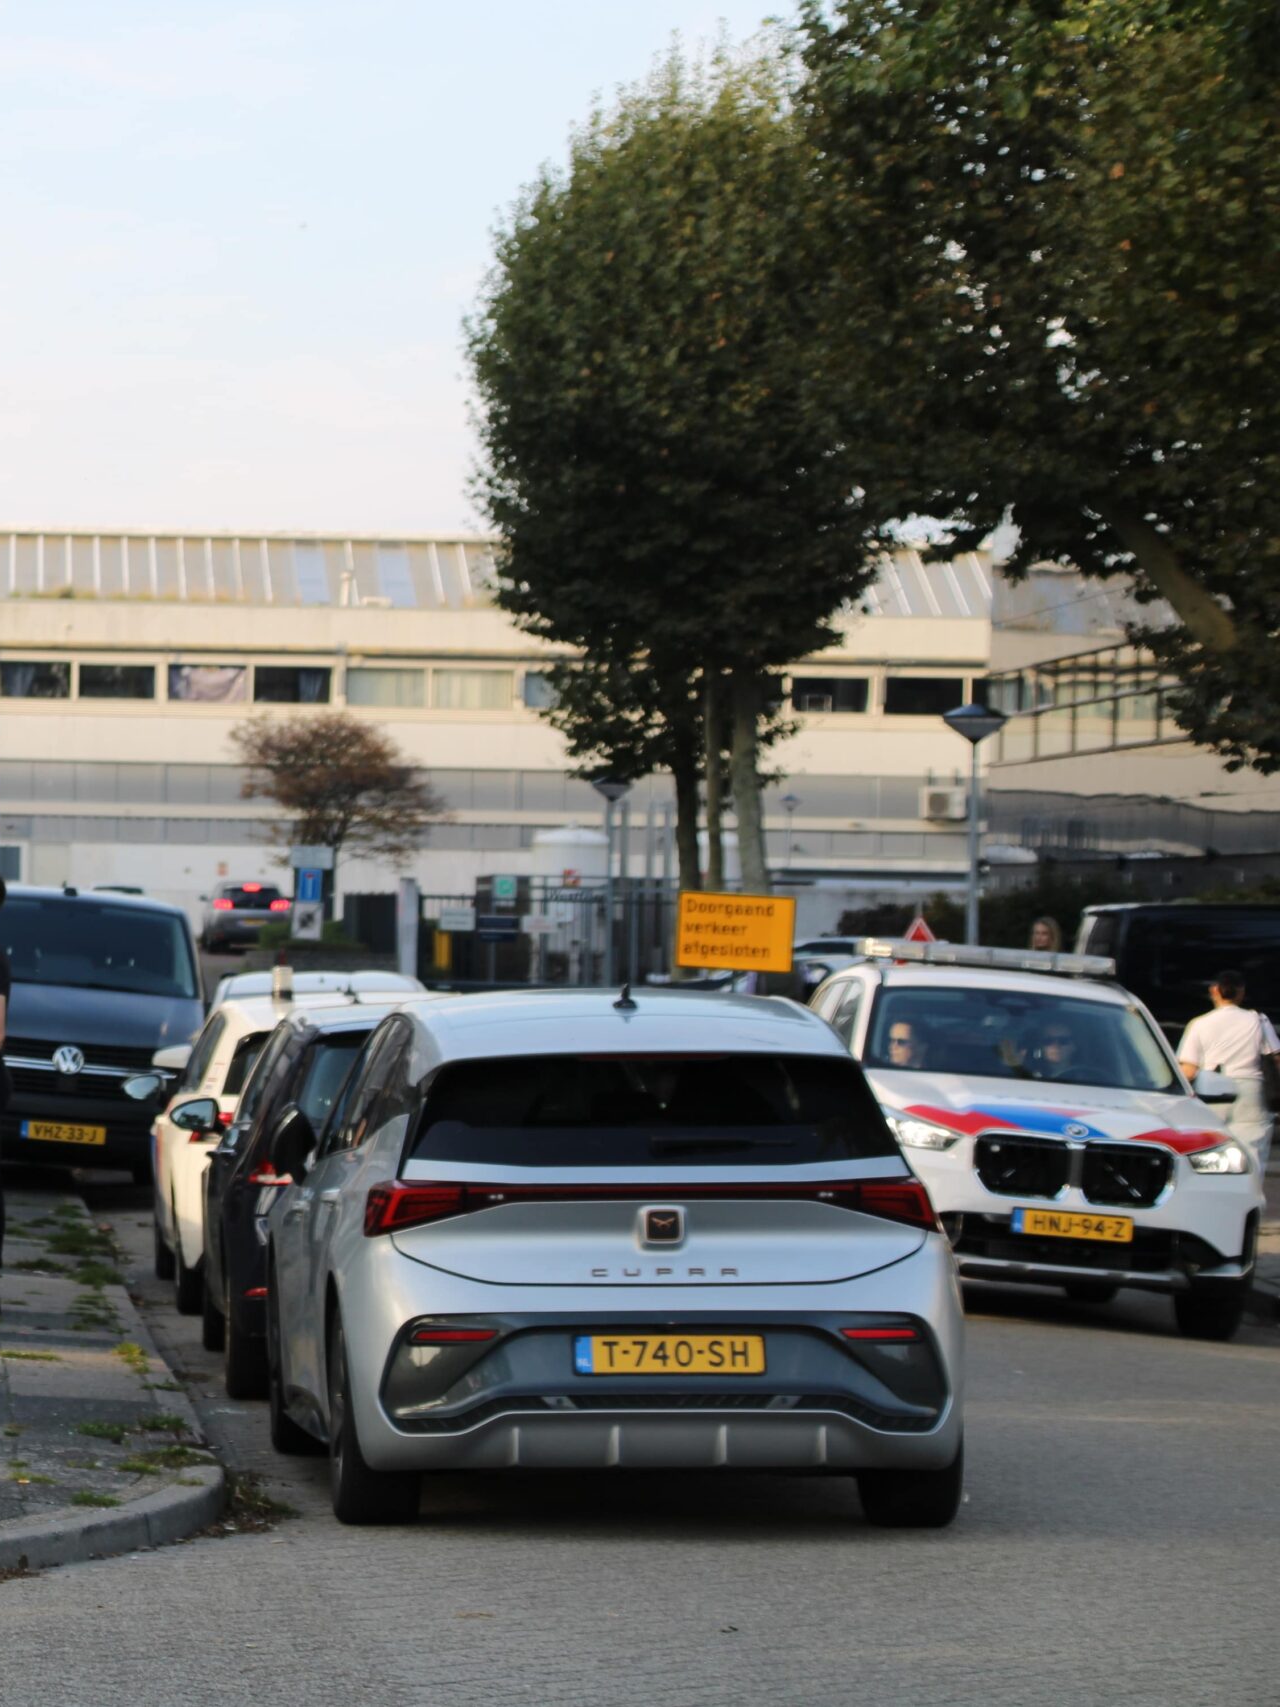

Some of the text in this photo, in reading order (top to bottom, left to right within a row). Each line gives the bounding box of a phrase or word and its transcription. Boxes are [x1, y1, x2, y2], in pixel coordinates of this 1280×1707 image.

[685, 899, 776, 919] Doorgaand
[684, 921, 748, 936] verkeer
[683, 942, 771, 959] afgesloten
[1033, 1214, 1126, 1239] HNJ-94-Z
[591, 1267, 739, 1277] CUPRA
[602, 1340, 750, 1368] T-740-SH
